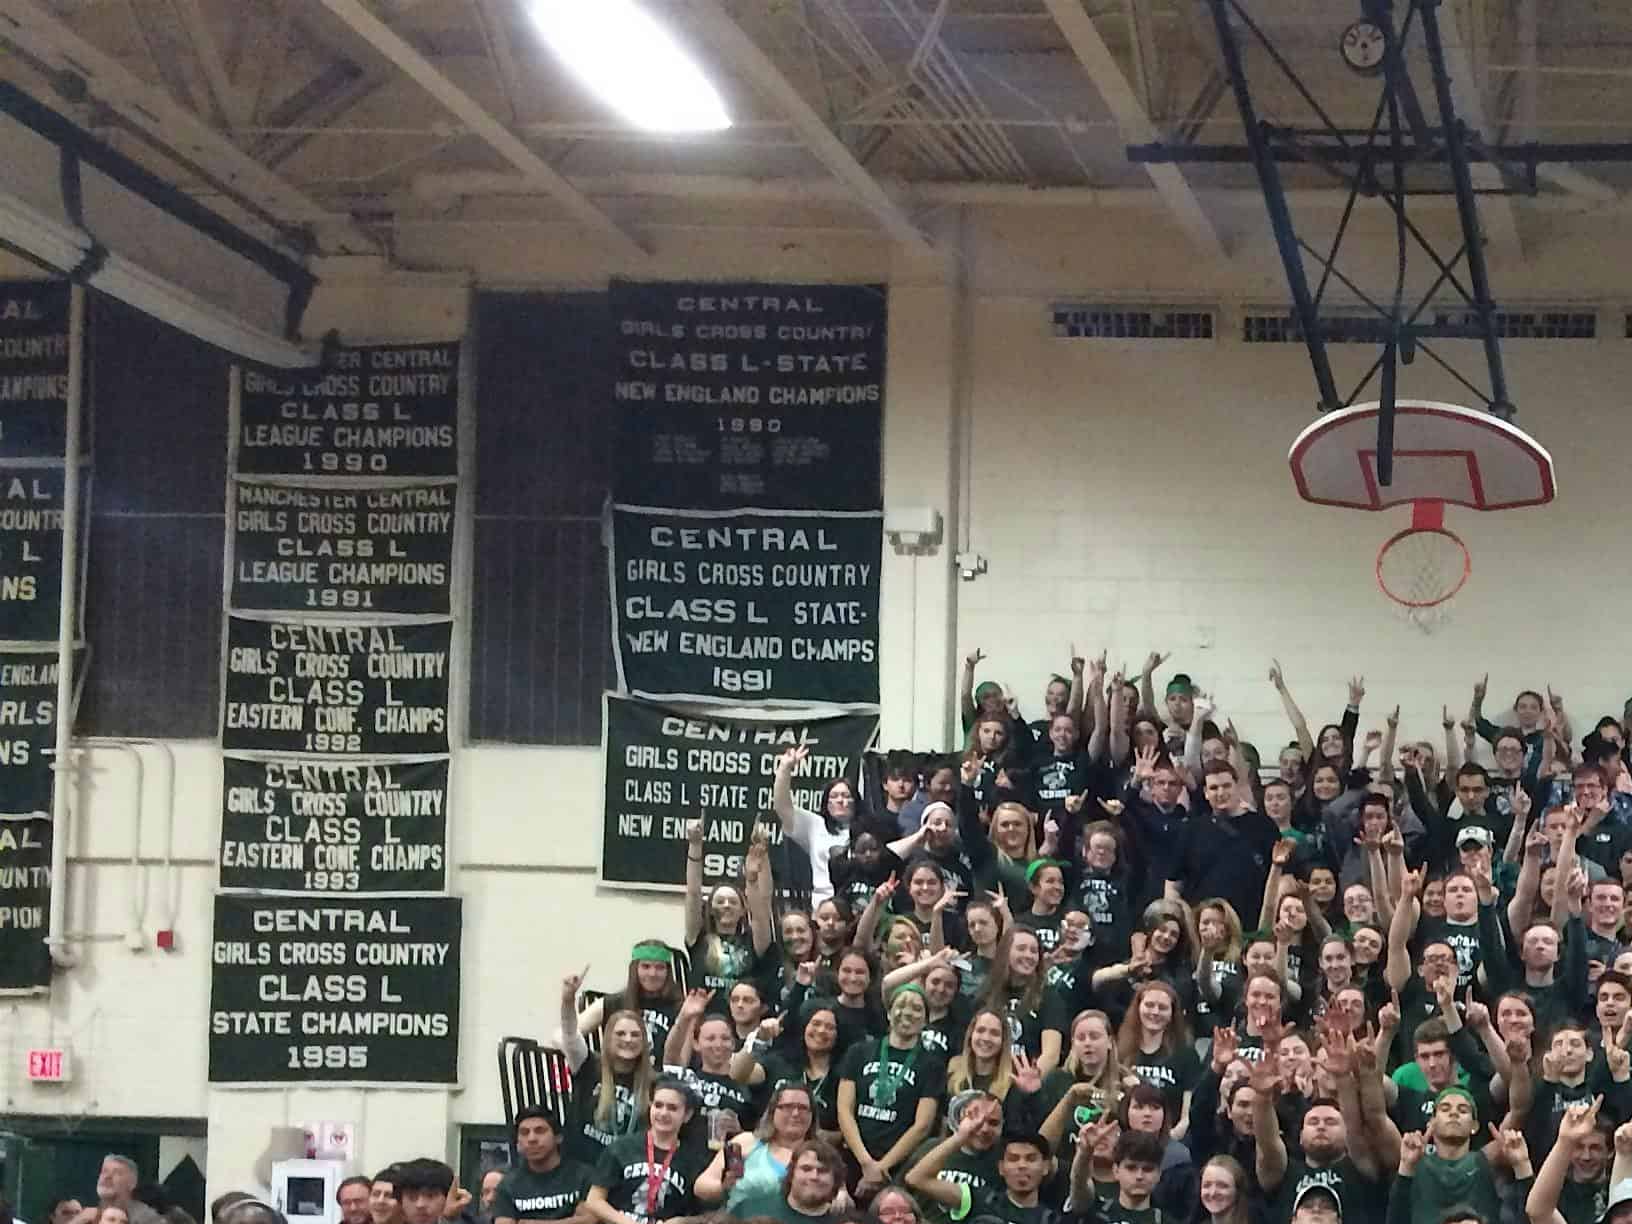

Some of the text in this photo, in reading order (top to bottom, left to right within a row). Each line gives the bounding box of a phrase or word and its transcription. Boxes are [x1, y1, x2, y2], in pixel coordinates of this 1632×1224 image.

[677, 297, 824, 313] CENTRAL
[621, 320, 685, 338] GIRLS
[695, 324, 767, 340] CROSS
[629, 350, 728, 371] CLASS
[368, 373, 450, 397] COUNTRY
[616, 382, 879, 405] NEW ENGLAND CHAMPIONS
[281, 403, 411, 421] CLASS L
[245, 425, 453, 448] LEAGUE CHAMPIONS
[303, 454, 388, 472] 1990
[238, 510, 450, 535] GIRLS CROSS COUNTRY
[276, 538, 407, 557] CLASS L
[651, 527, 837, 551] CENTRAL
[240, 562, 446, 585] LEAGUE CHAMPIONS
[627, 560, 871, 587] GIRLS CROSS COUNTRY
[306, 589, 373, 608] 1991
[626, 596, 736, 623] CLASS
[748, 602, 768, 623] L
[271, 624, 404, 653] CENTRAL
[626, 630, 875, 663] NEW ENGLAND CHAMPS
[1, 664, 58, 686] ENGLAN
[230, 648, 445, 680] GIRLS CROSS COUNTRY
[714, 667, 772, 691] 1991
[269, 677, 403, 706] CLASS L
[0, 701, 53, 725] RLS
[227, 703, 303, 731] EASTERN
[375, 707, 445, 734] CHAMPS
[305, 734, 361, 752] 1992
[625, 745, 678, 771] GIRLS
[687, 749, 751, 774] CROSS
[265, 764, 401, 792] CENTRAL
[227, 787, 443, 817] GIRLS CROSS COUNTRY
[625, 779, 672, 804] CLASS
[680, 782, 690, 806] L
[700, 785, 748, 809] STATE
[265, 816, 401, 844] CLASS L
[618, 814, 652, 837] NEW
[223, 842, 303, 870] EASTERN
[370, 844, 443, 872] CHAMPS
[304, 872, 360, 889] 1993
[253, 910, 411, 933] CENTRAL
[214, 943, 449, 966] GIRLS CROSS COUNTRY
[259, 976, 402, 1002] CLASS L
[213, 1012, 449, 1036] STATE CHAMPIONS
[30, 1051, 63, 1077] EXIT
[288, 1045, 368, 1068] 1995
